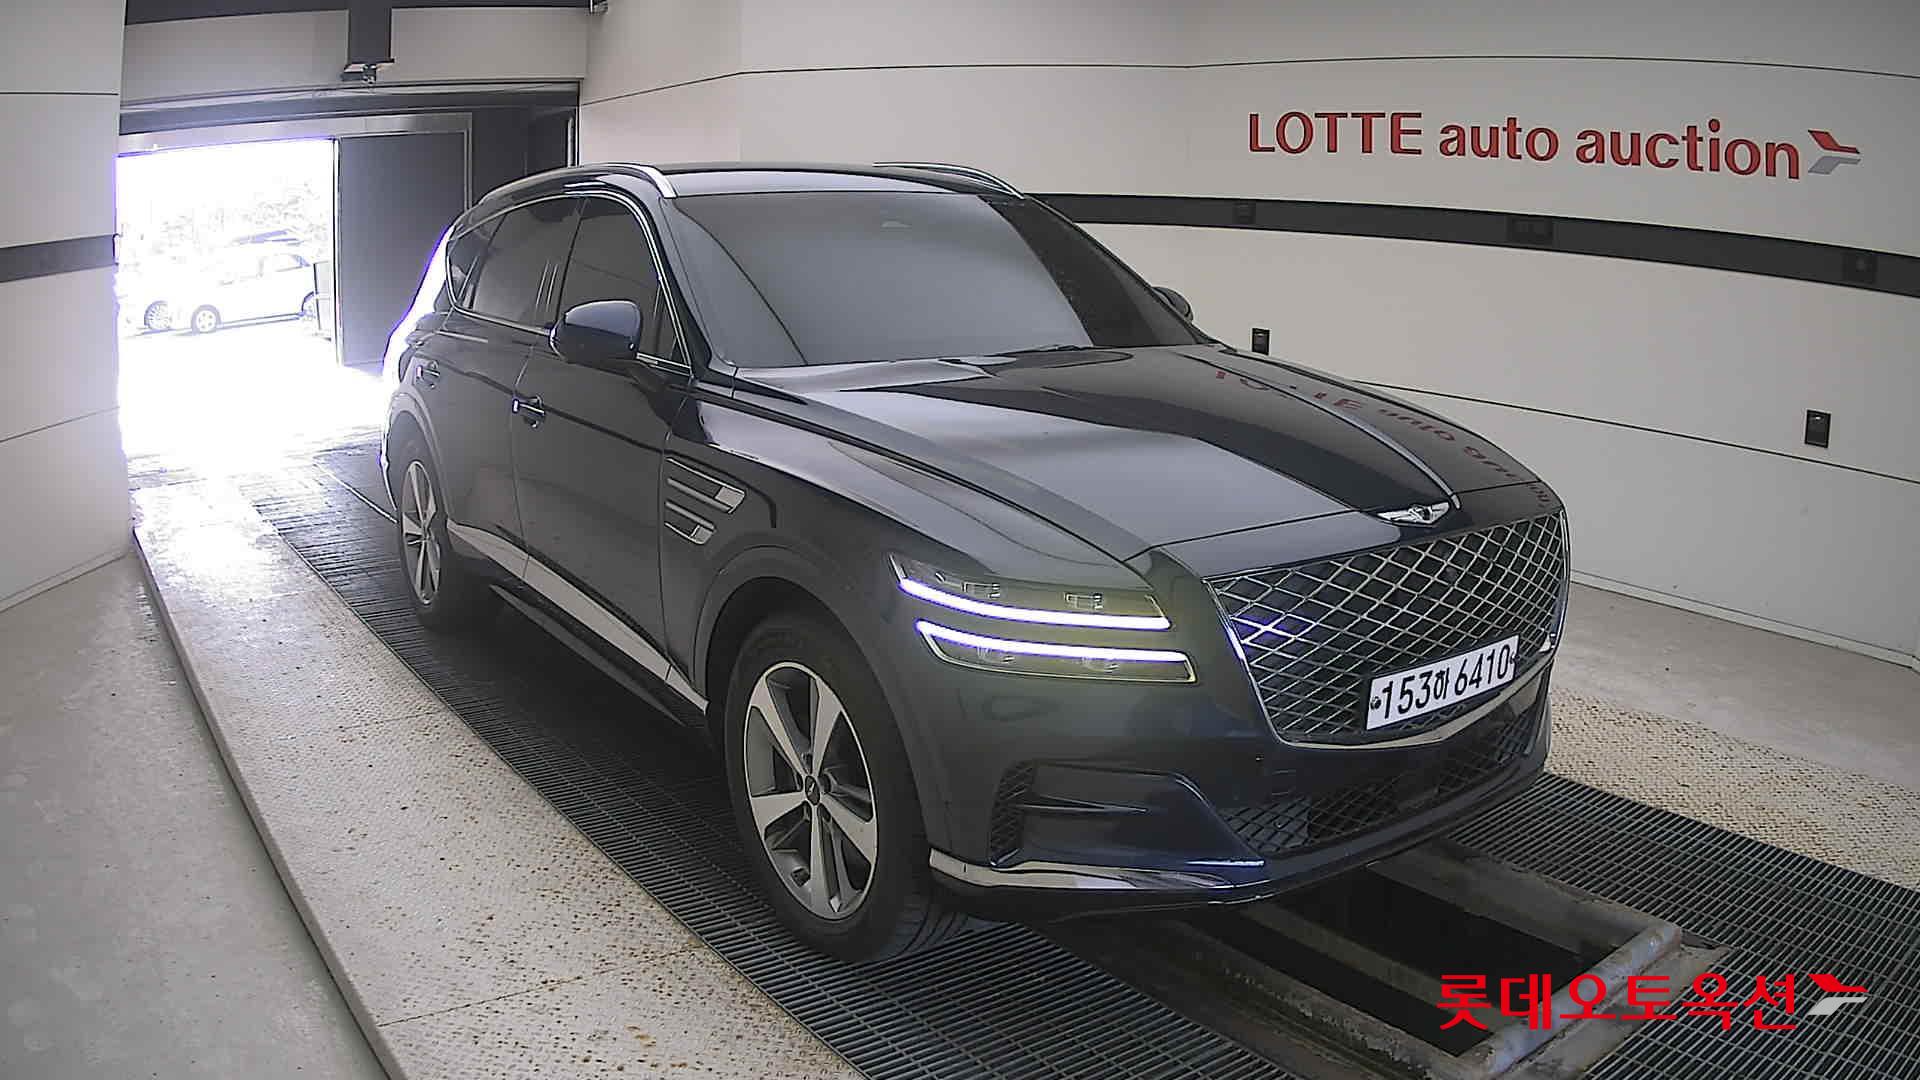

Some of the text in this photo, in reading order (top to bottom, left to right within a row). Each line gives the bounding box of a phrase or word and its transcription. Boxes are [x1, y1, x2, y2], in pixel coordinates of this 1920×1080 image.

[1249, 111, 1801, 179] LOTTE auto auction
[1454, 644, 1511, 696] 6410
